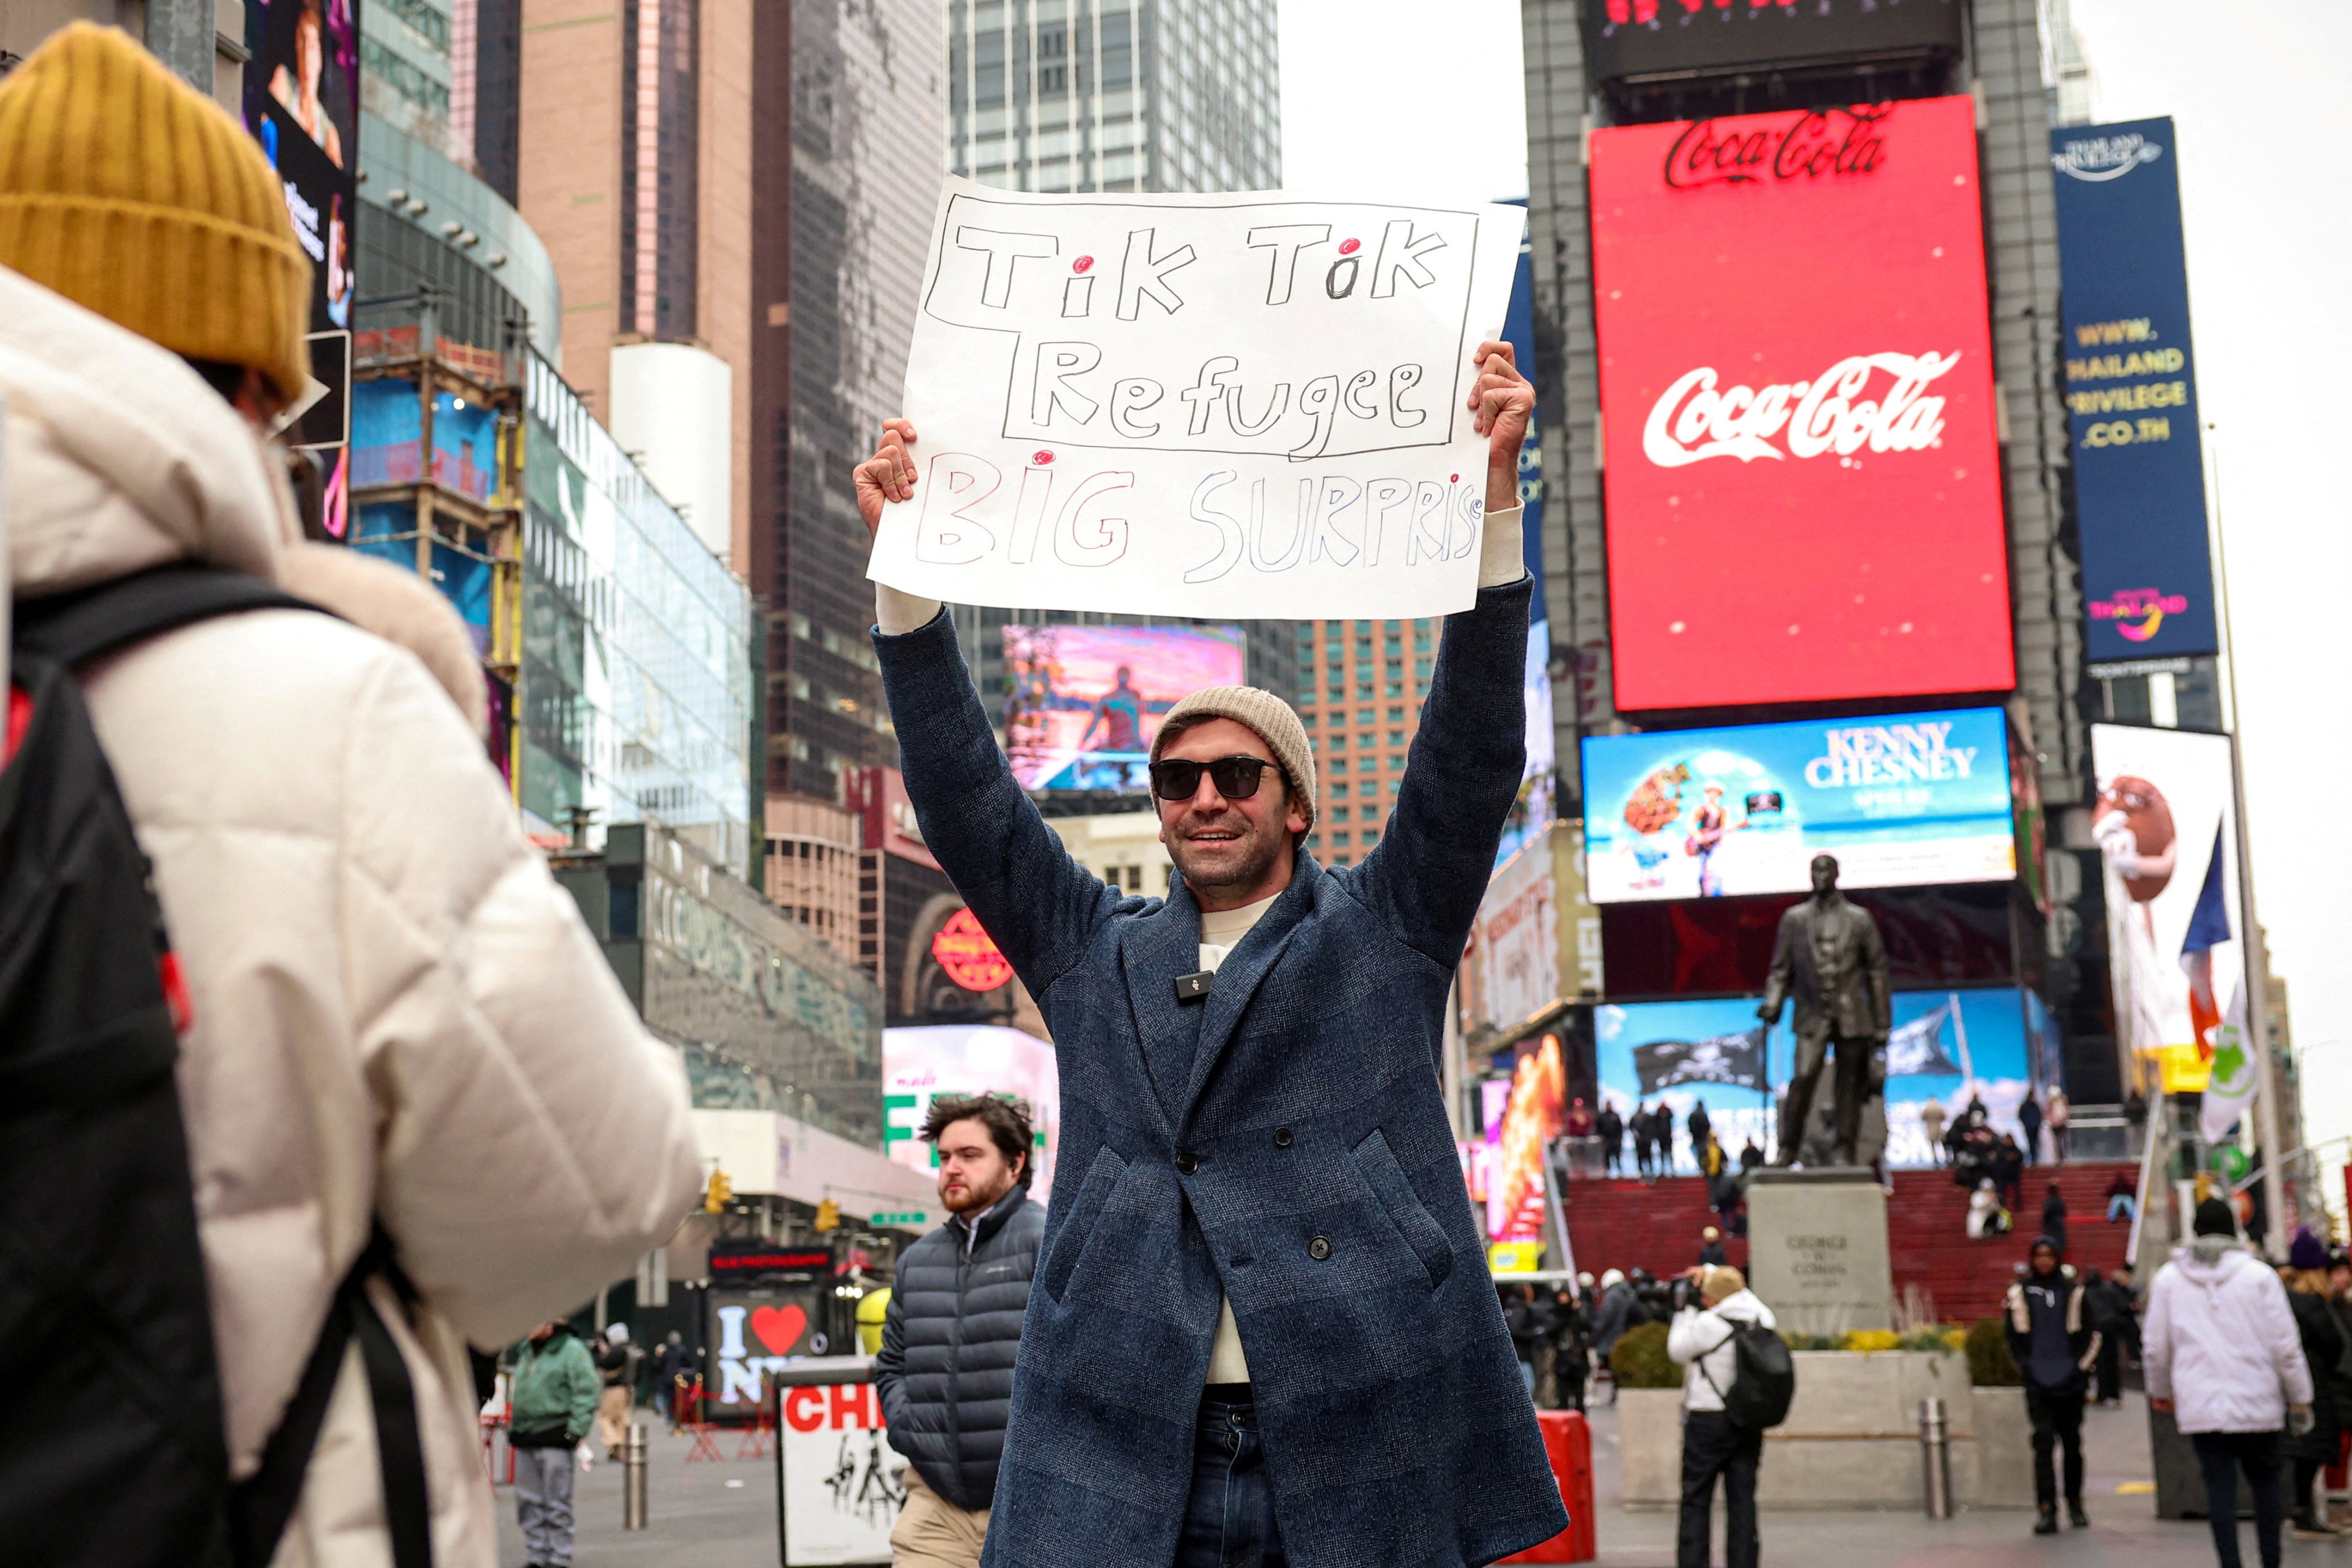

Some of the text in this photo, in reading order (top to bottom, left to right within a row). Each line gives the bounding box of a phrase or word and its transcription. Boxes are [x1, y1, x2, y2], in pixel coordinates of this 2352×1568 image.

[1664, 102, 1895, 189] Coca-Cola
[2066, 347, 2185, 381] HAILAND
[1030, 341, 1427, 462] Refugee
[1643, 350, 1963, 468] Coca-Cola
[1825, 721, 1953, 759] KENNY
[1805, 748, 1977, 787] CHESNEY
[717, 1306, 747, 1359] I
